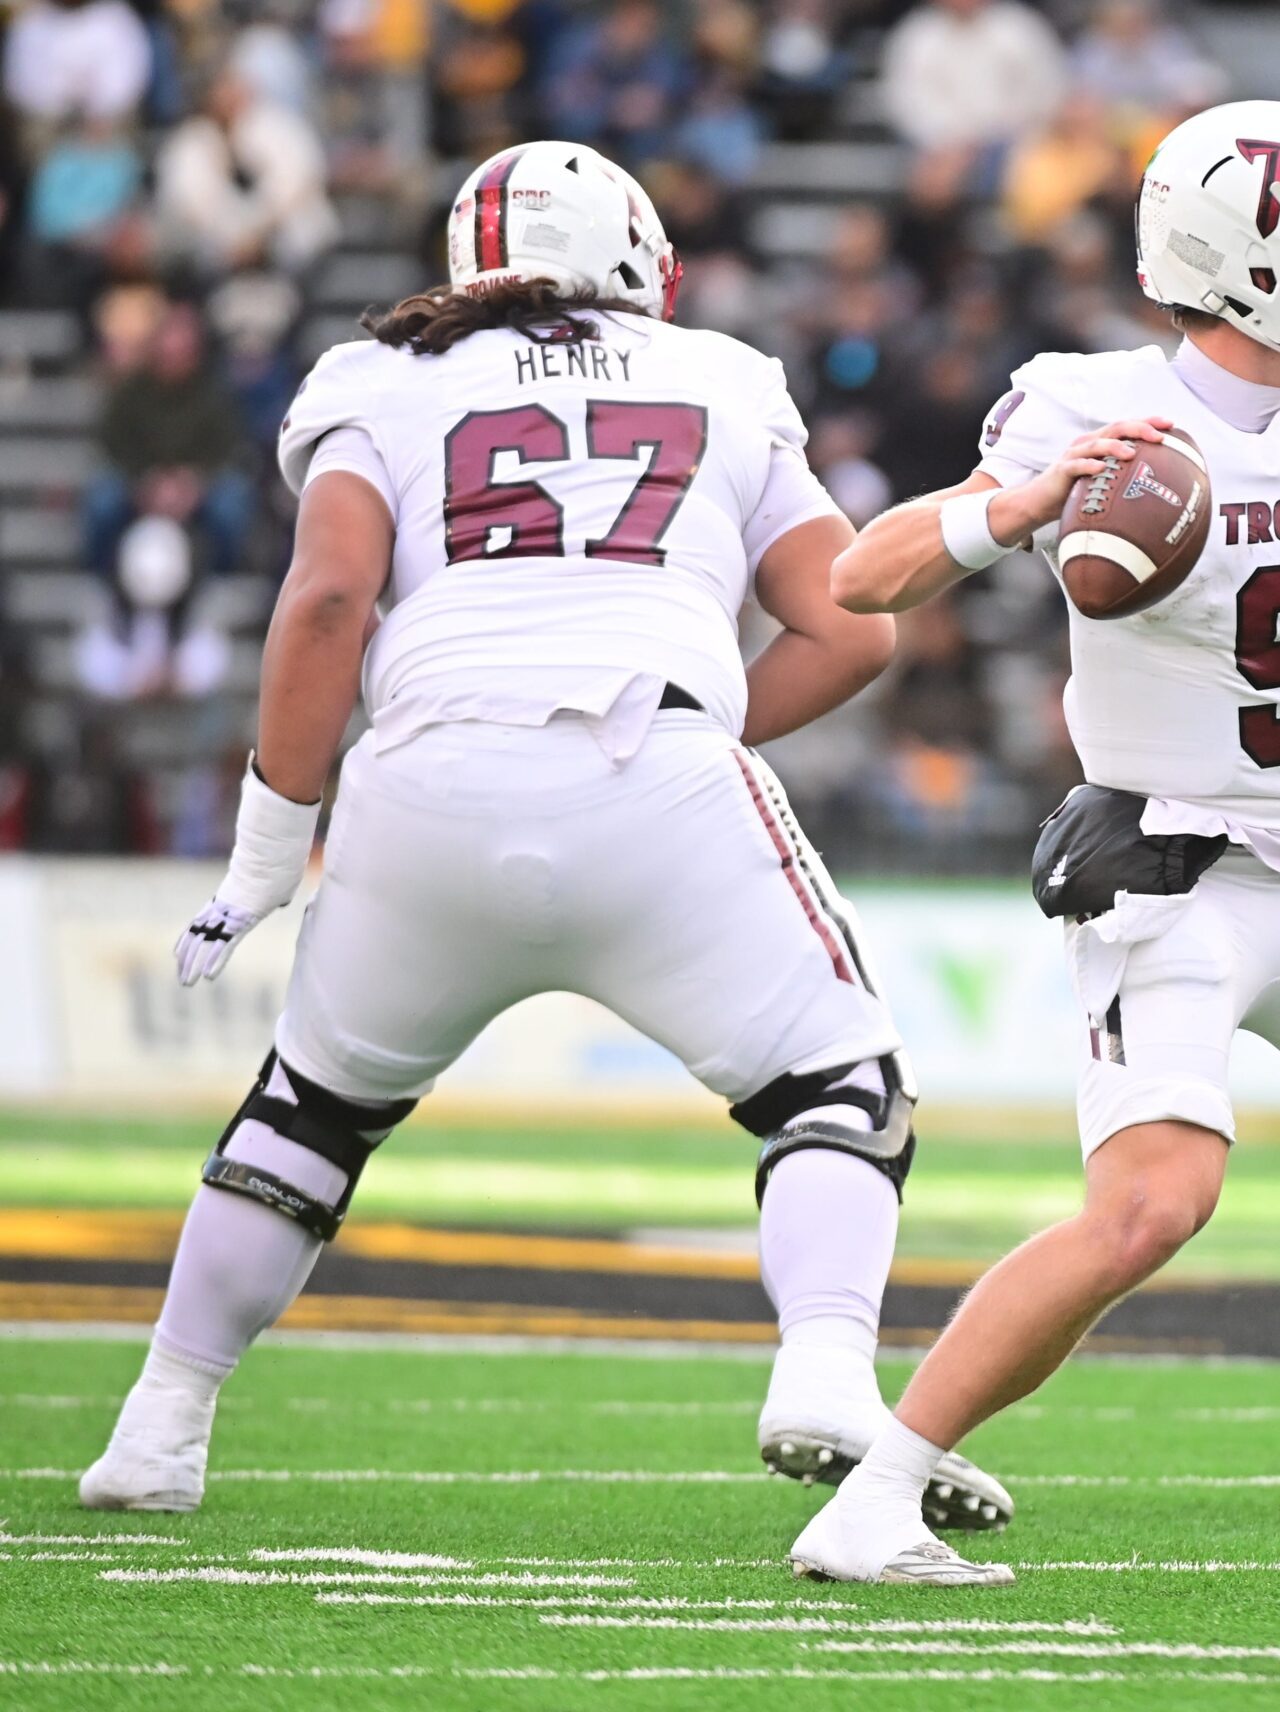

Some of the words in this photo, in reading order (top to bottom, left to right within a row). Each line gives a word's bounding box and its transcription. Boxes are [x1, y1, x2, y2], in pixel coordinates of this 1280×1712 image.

[512, 189, 551, 208] SBC
[513, 342, 632, 385] HENRY
[985, 389, 1026, 448] 9
[443, 398, 709, 568] 67
[247, 1176, 308, 1211] DONJOY
